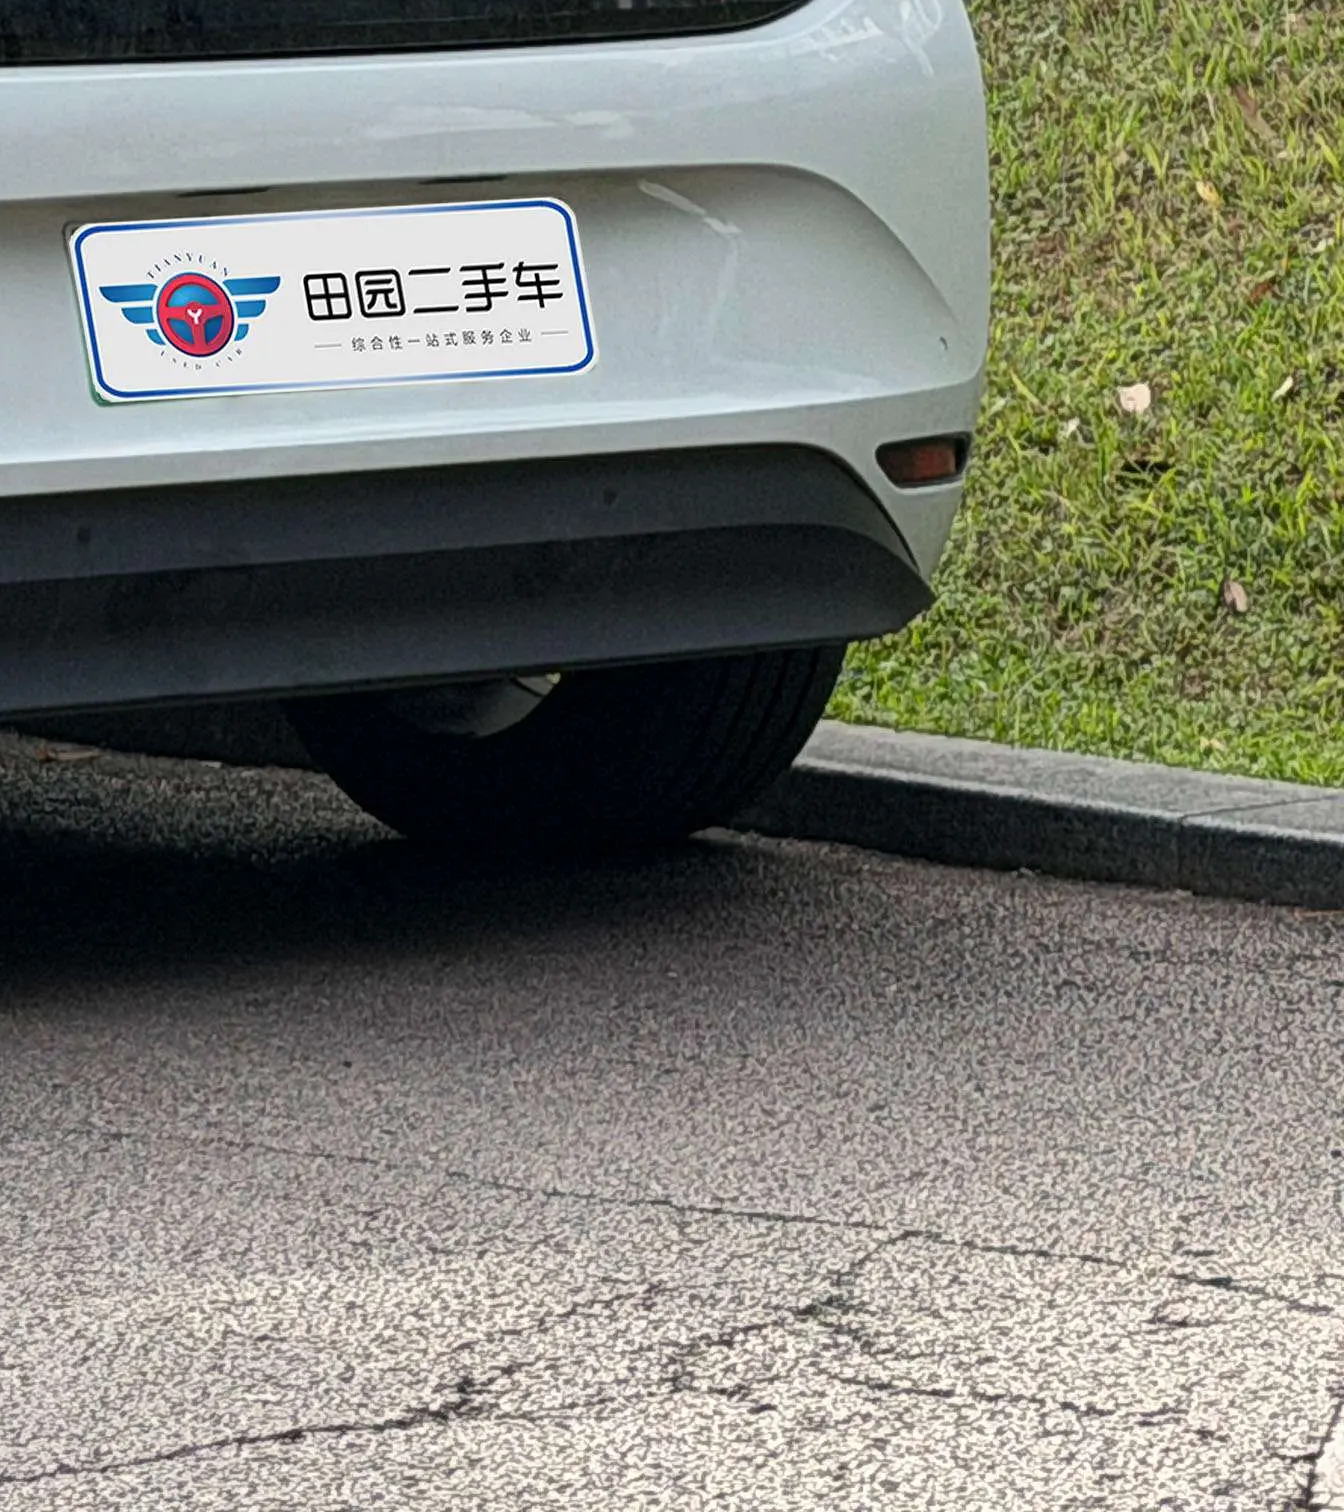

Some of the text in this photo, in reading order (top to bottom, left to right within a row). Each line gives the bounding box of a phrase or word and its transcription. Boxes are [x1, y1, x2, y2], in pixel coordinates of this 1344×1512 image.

[302, 260, 565, 322] 田园二手车
[350, 327, 533, 353] 综合性一站式服务企业
